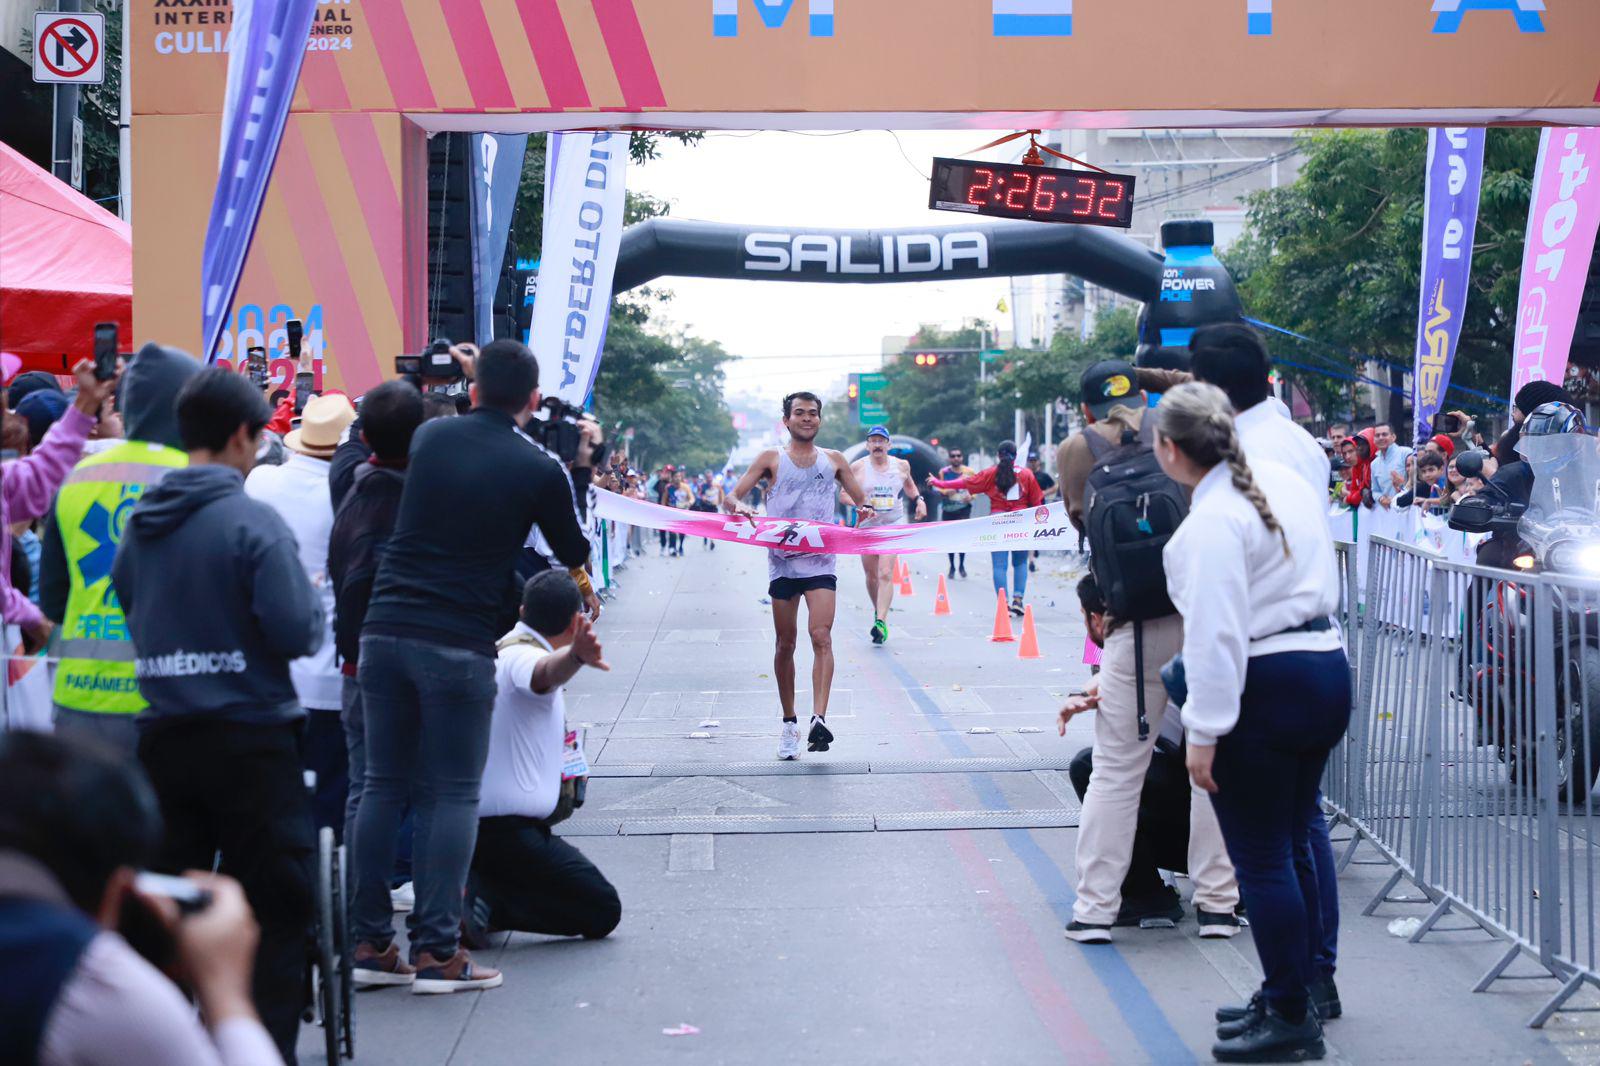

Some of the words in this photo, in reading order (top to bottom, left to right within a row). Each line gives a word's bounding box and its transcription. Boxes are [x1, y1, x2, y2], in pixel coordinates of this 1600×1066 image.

[307, 36, 353, 51] 2024
[744, 231, 989, 274] SALIDA
[1161, 278, 1216, 291] POWER
[722, 519, 825, 548] 42K
[1003, 531, 1029, 540] IMDEC
[1033, 527, 1068, 538] IAAF
